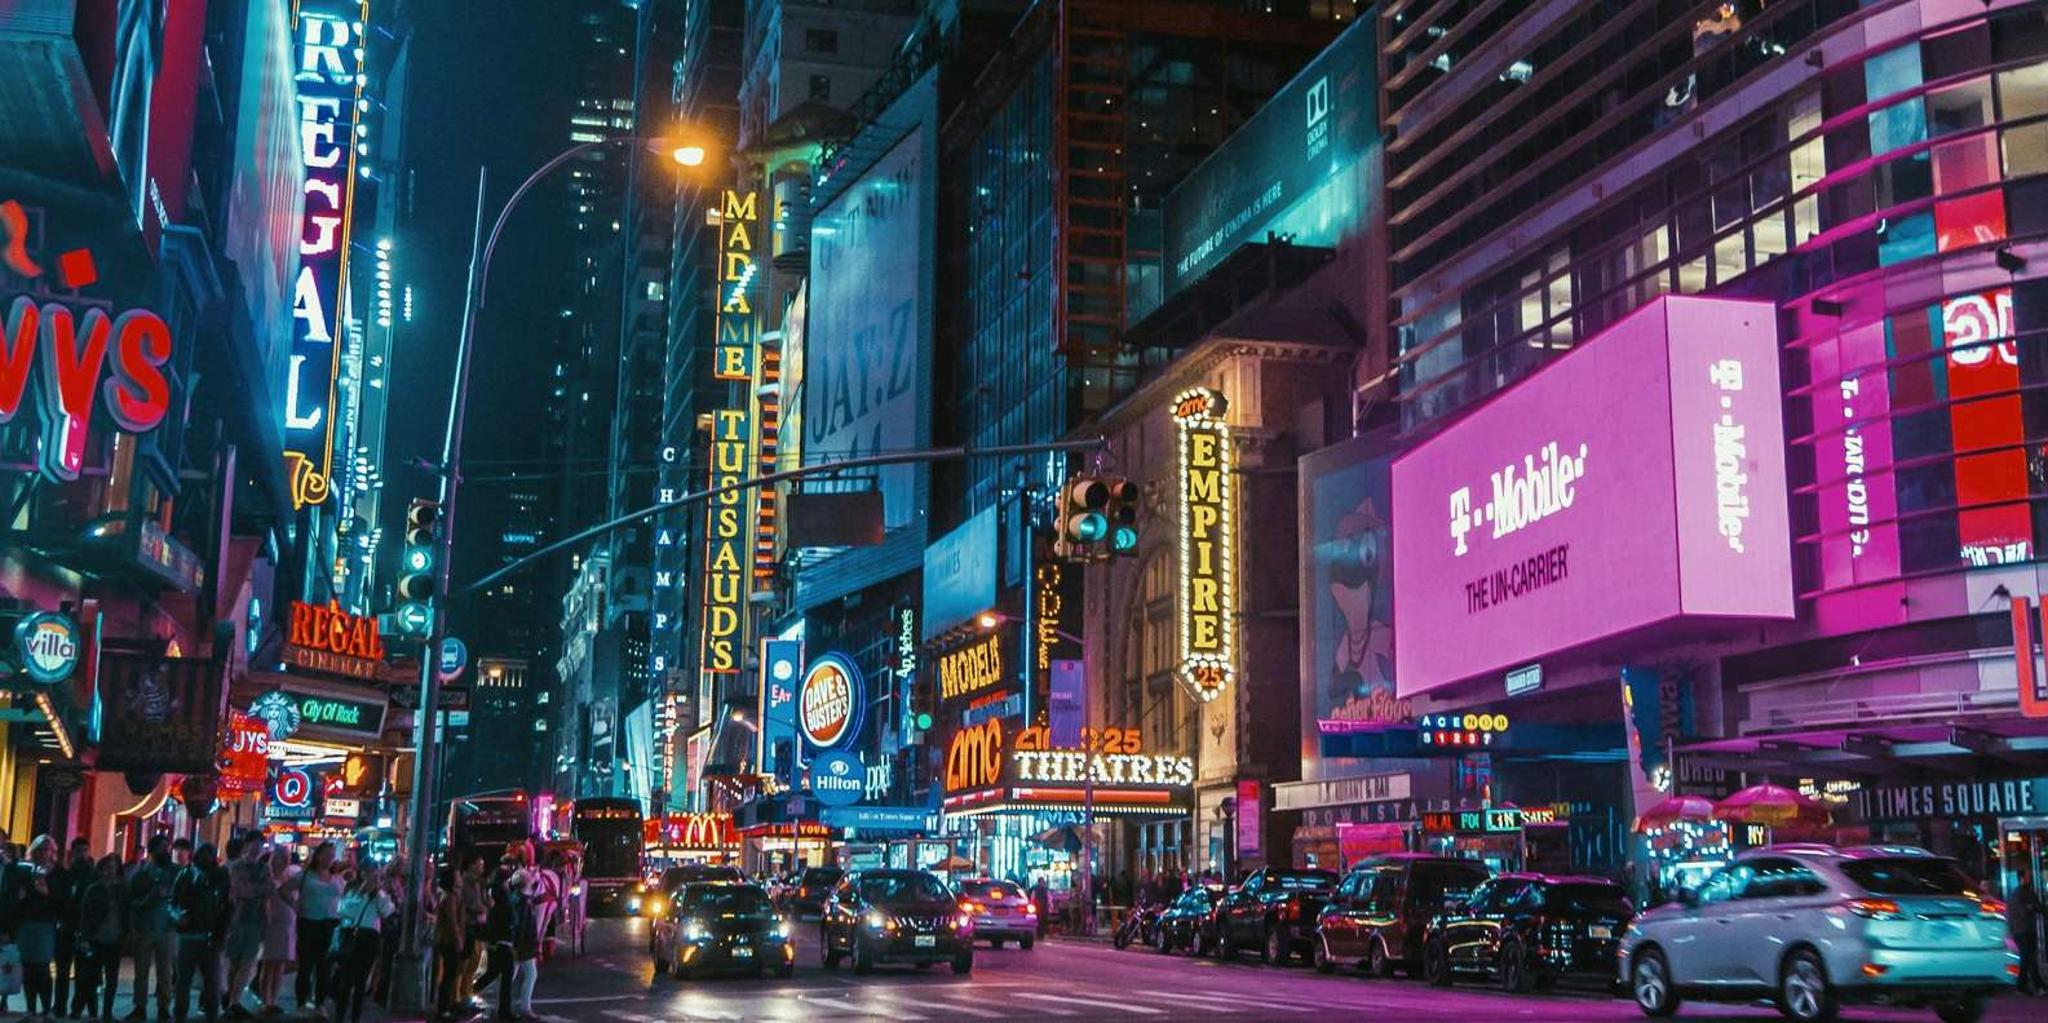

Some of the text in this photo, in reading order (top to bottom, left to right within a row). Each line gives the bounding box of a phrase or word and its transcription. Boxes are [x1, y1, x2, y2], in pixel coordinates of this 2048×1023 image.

[284, 16, 353, 431] REGAL
[723, 190, 757, 378] MADAME
[708, 410, 746, 670] TUSSAUD'S
[1188, 433, 1221, 648] EMPIRE
[654, 447, 676, 671] CHAMPS
[1466, 576, 1489, 615] THE
[25, 633, 75, 660] villa
[290, 600, 385, 662] REGAL
[805, 676, 837, 712] DAVE
[1198, 668, 1222, 687] 25
[303, 700, 360, 725] City Of Rock
[807, 695, 848, 732] BUSTER'S
[1422, 715, 1431, 727] A
[1438, 717, 1446, 727] C
[1453, 716, 1461, 727] E
[1102, 727, 1143, 754] 25
[1483, 733, 1492, 743] 7
[816, 776, 861, 790] Hilton
[1014, 751, 1194, 786] THEATRES
[1876, 785, 1934, 818] TIMES
[1943, 780, 2033, 816] SQUARE
[1747, 825, 1764, 845] NY
